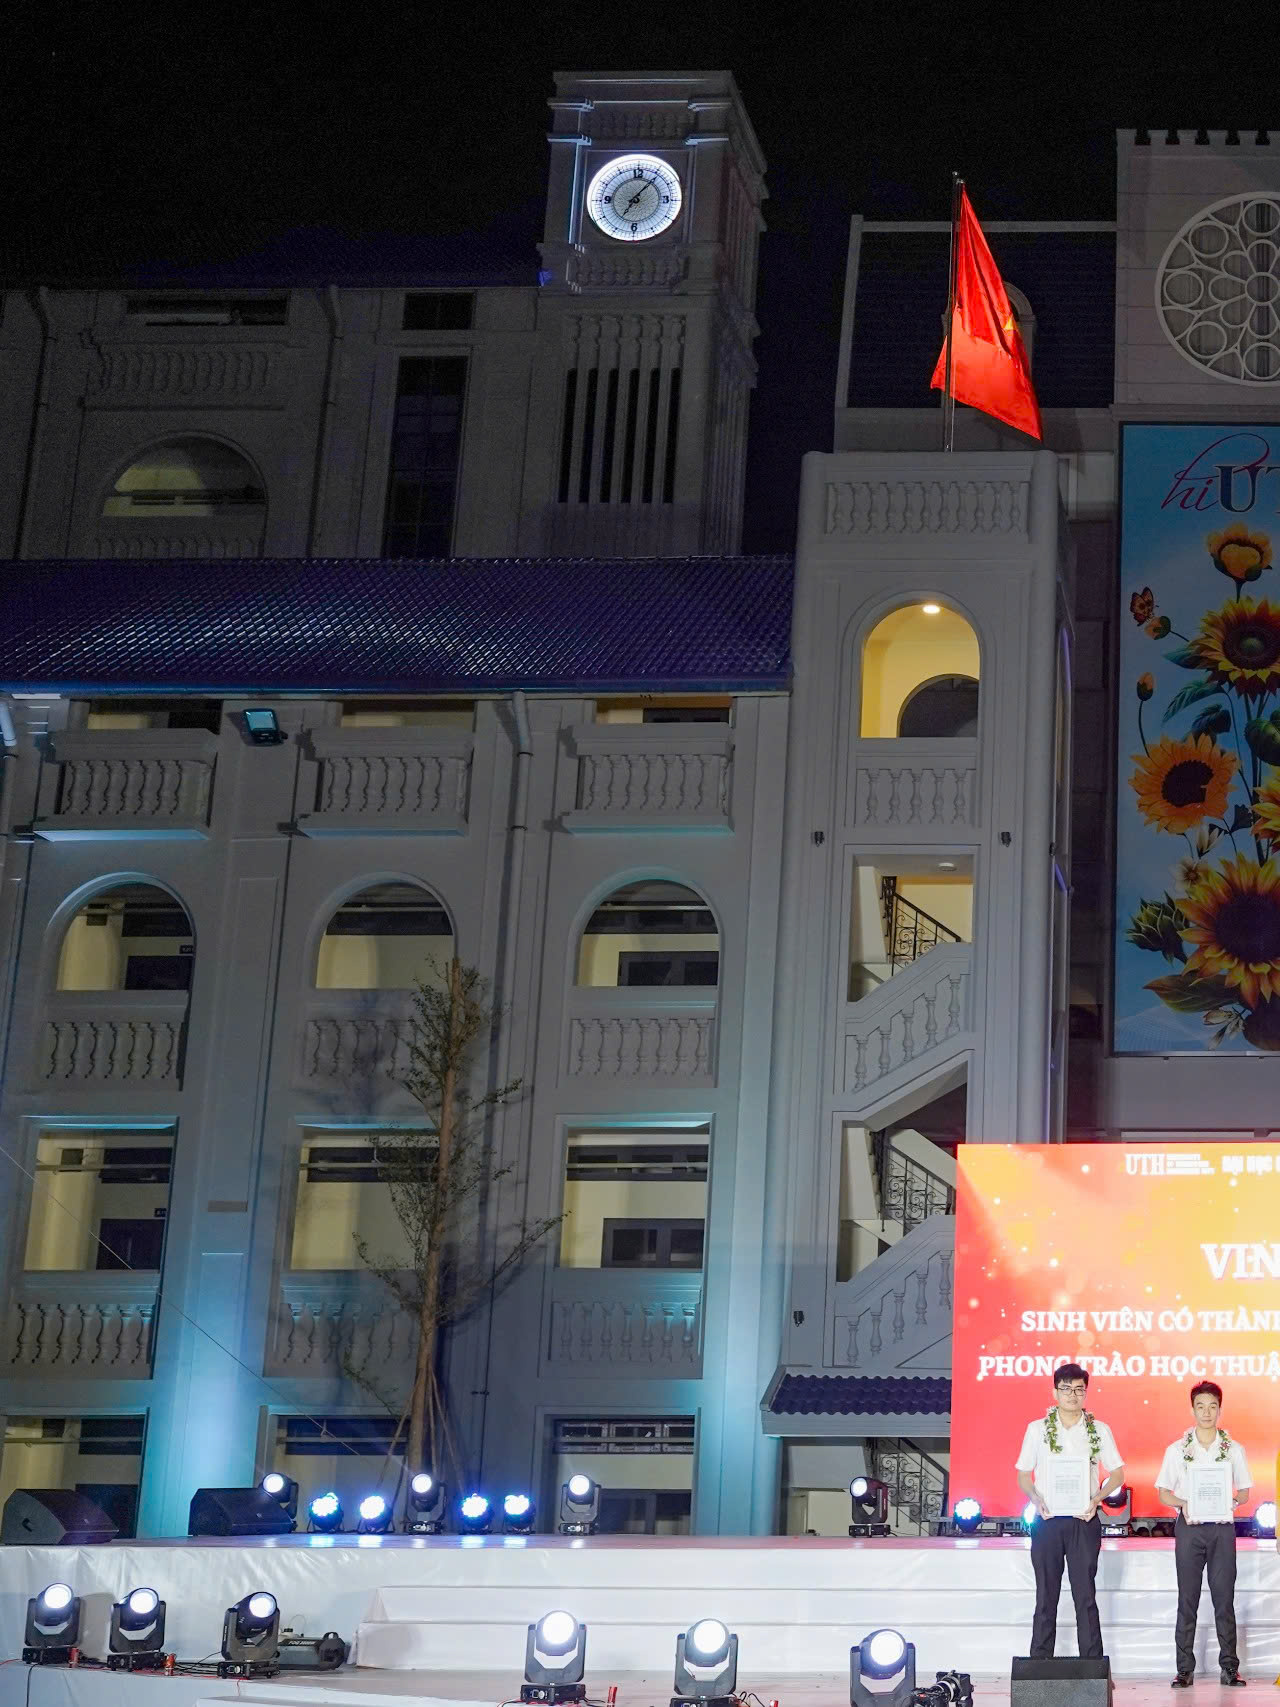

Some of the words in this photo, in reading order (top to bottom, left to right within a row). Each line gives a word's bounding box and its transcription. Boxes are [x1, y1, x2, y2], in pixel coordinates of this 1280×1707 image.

[633, 169, 644, 179] 12
[604, 195, 612, 205] 9
[662, 195, 670, 204] 3
[630, 222, 638, 232] 6
[1125, 1153, 1165, 1176] UTH
[1021, 1310, 1086, 1332] SINH
[1091, 1306, 1154, 1332] VIÊN
[1158, 1306, 1194, 1332] CÓ
[1075, 1350, 1146, 1377] TRÀO
[1150, 1355, 1206, 1382] HỌC
